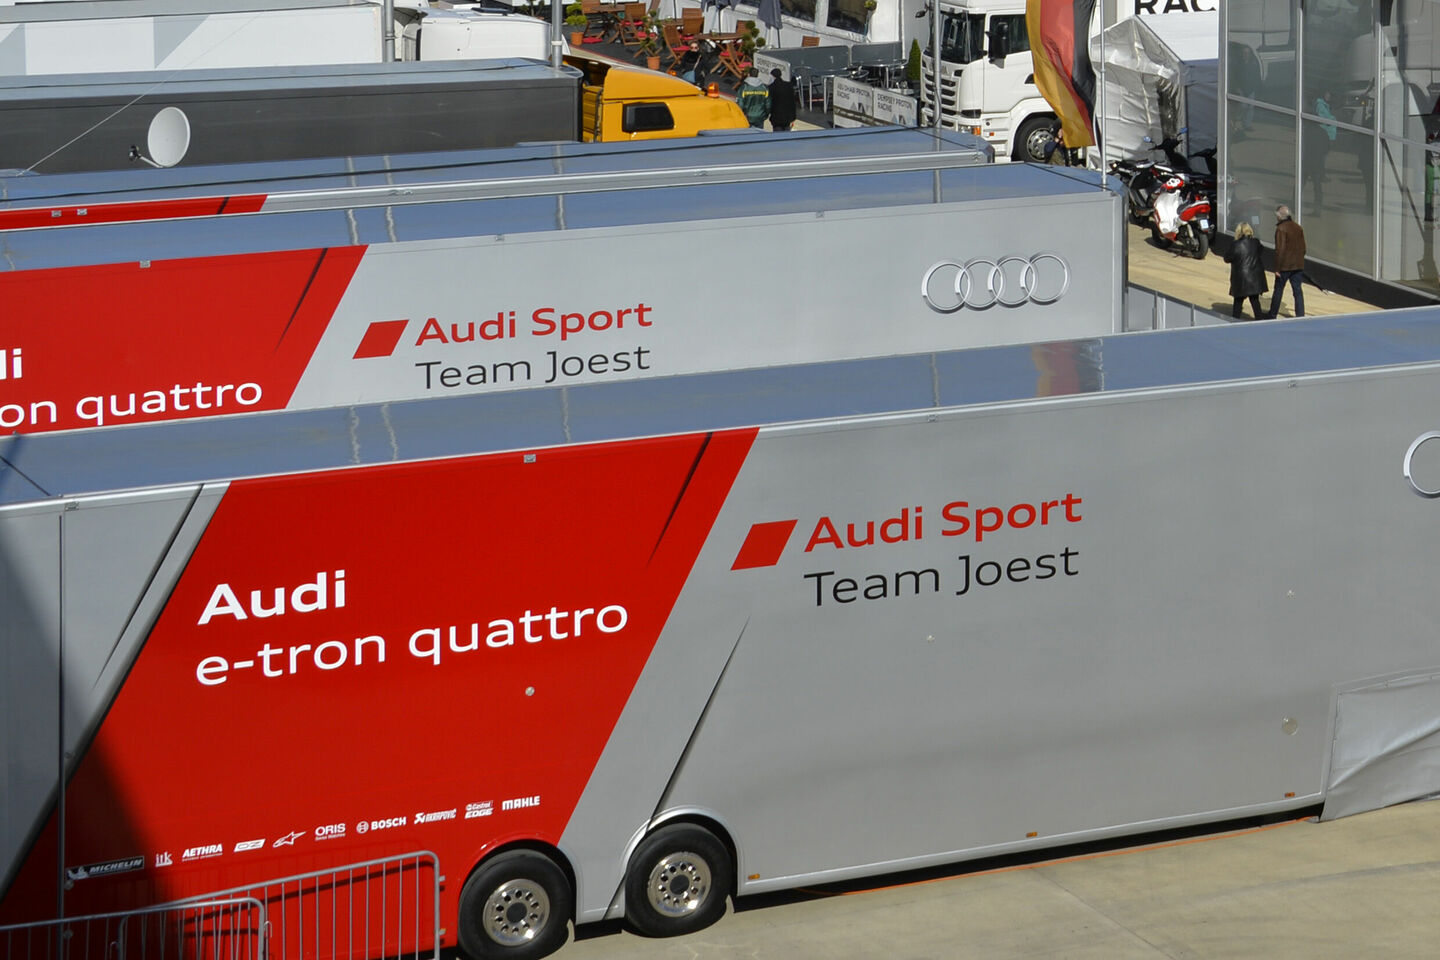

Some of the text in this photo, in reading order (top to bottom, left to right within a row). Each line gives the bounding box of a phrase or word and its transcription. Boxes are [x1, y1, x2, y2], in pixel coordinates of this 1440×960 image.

[414, 303, 653, 347] Audi Sport
[415, 345, 652, 391] Team Joest
[76, 379, 264, 427] quattro
[803, 492, 1083, 554] Audi Sport
[197, 569, 348, 626] Audi
[803, 545, 1080, 608] Team Joest
[195, 604, 629, 686] e-tron quattro
[371, 816, 407, 831] BOSCH
[464, 807, 494, 819] EDGE
[502, 795, 541, 811] MAHLE
[182, 843, 224, 858] AETHRA
[315, 822, 346, 837] ORIS
[89, 858, 143, 874] MICHELIN
